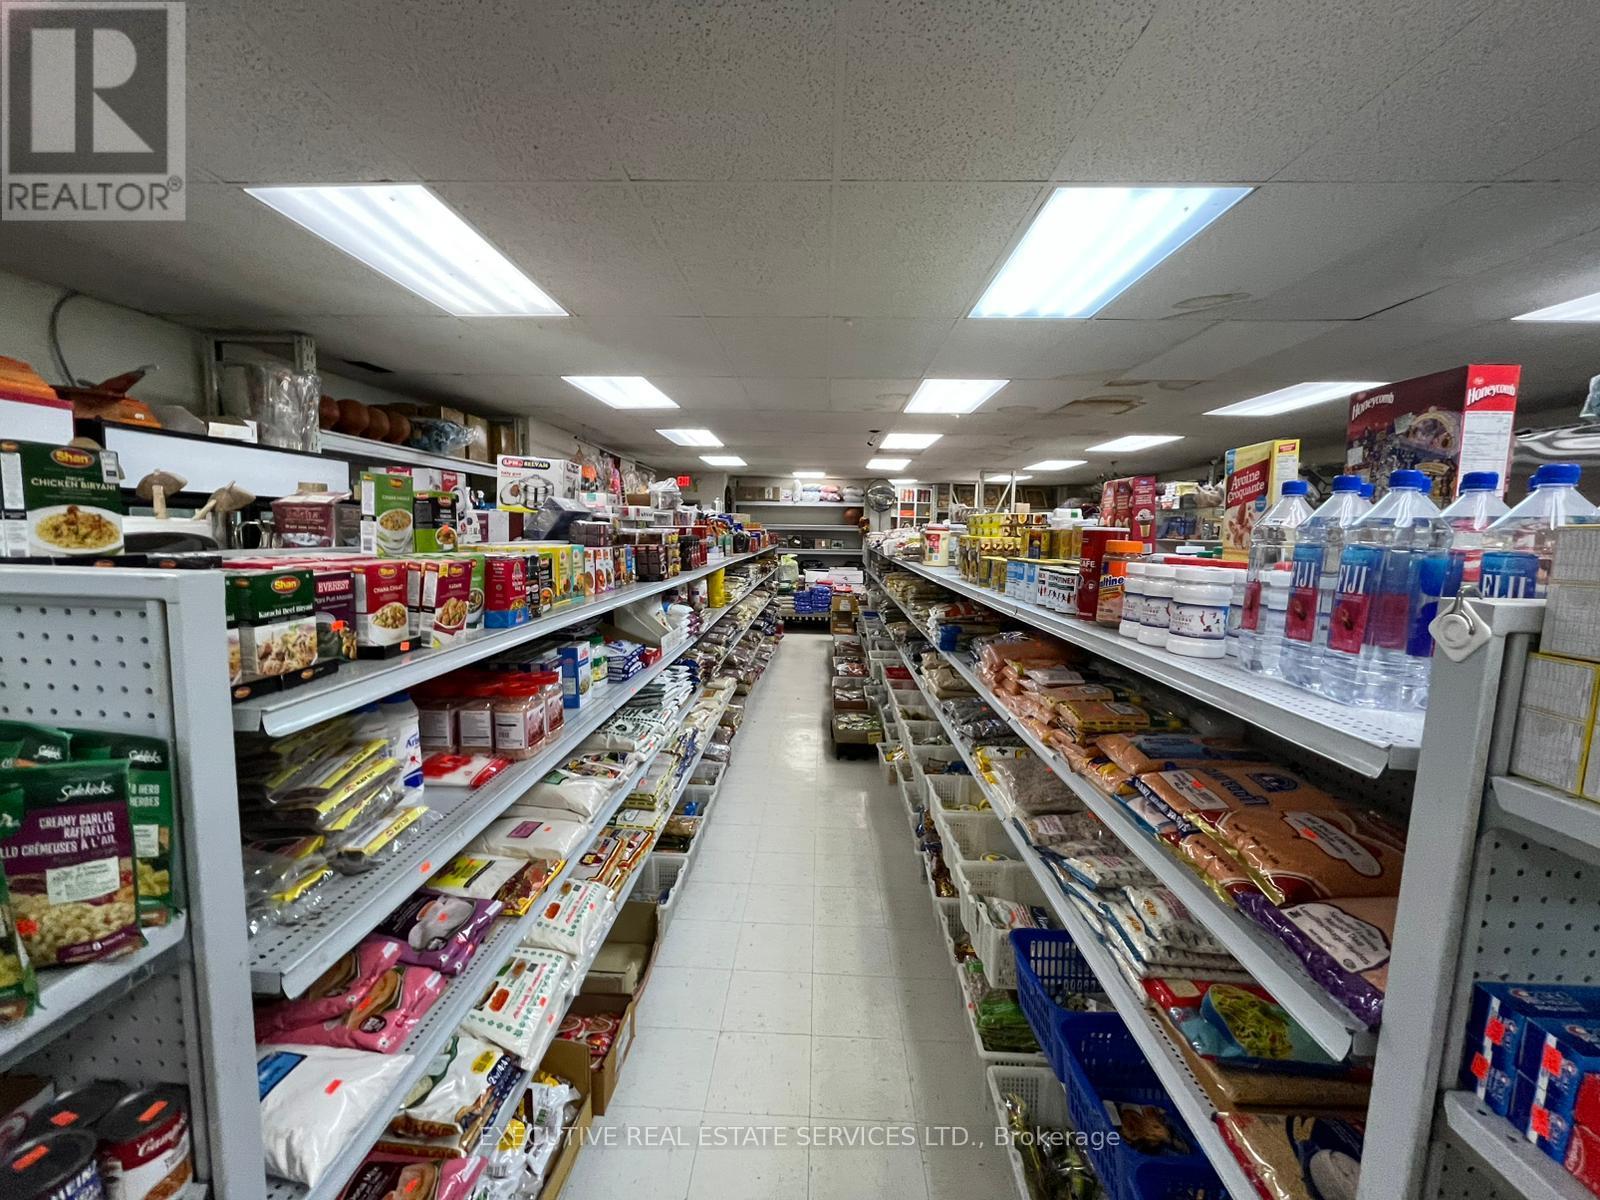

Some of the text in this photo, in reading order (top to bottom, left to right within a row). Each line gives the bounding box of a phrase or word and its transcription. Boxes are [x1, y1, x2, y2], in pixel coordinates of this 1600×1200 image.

[1467, 384, 1515, 406] Honeycomb
[1351, 392, 1394, 420] Honeycomb
[55, 450, 89, 464] Shan
[31, 478, 79, 489] CHICKEN
[80, 480, 116, 491] BIRYANI
[1231, 470, 1260, 491] Avoine
[1227, 481, 1265, 503] Croquante
[274, 579, 297, 590] Shan
[317, 580, 350, 593] EVEREST
[1337, 564, 1368, 595] FIJI
[258, 609, 281, 619] Karachi
[57, 780, 115, 802] Sidekicks
[38, 811, 114, 829] CREAMY GARLIC
[63, 822, 116, 839] RAFFAELLO
[21, 841, 78, 857] CRÉMEUSES
